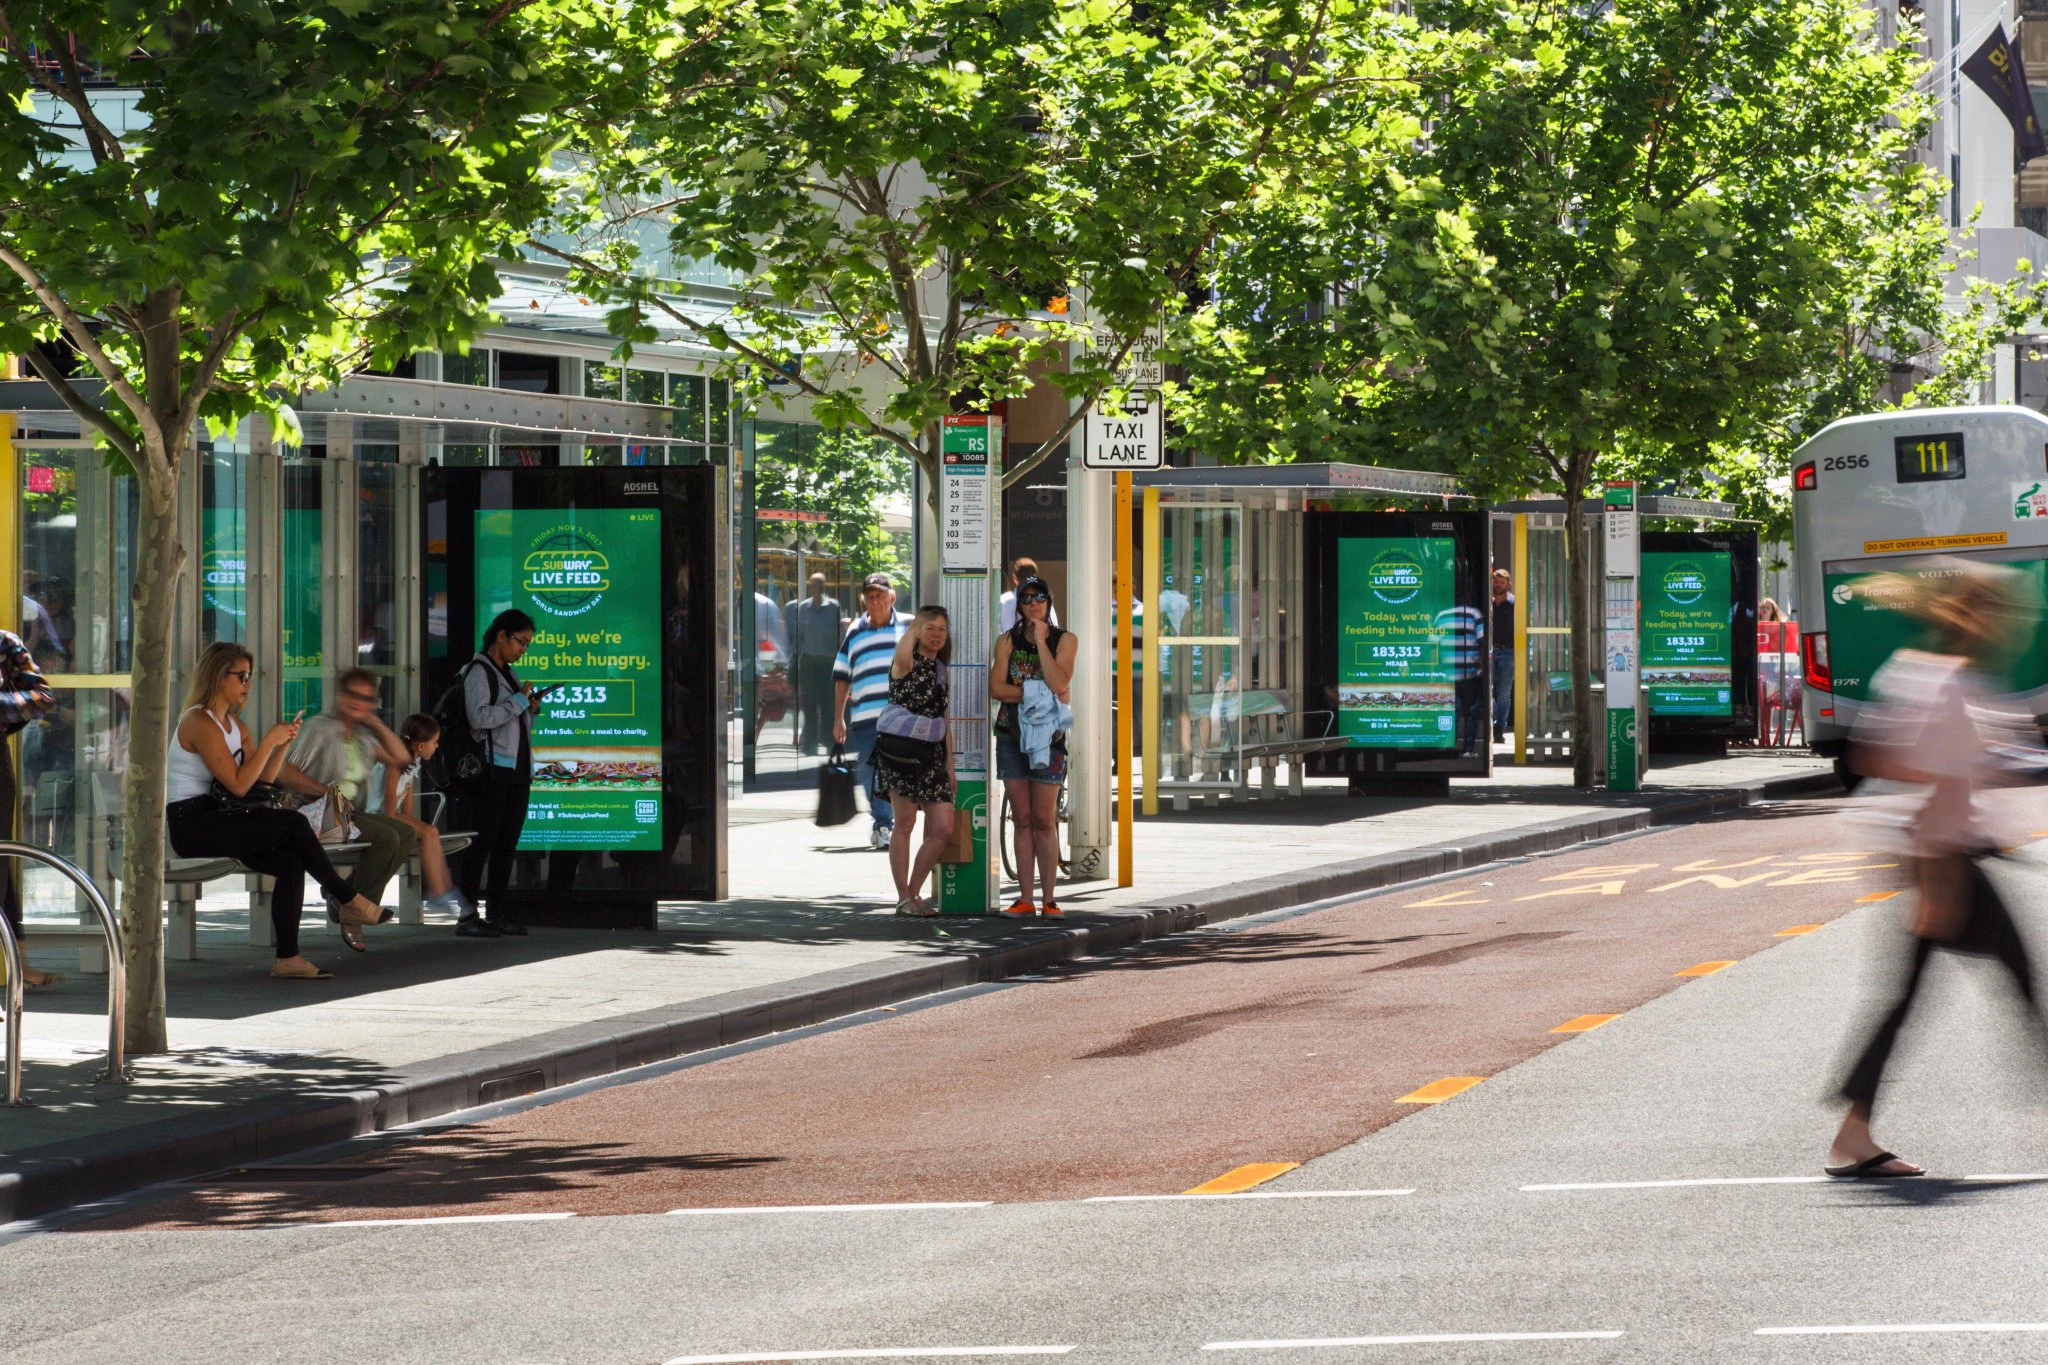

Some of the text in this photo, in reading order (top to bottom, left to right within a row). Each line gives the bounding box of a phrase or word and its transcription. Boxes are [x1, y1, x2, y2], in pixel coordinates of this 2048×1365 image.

[1136, 367, 1159, 379] LANE
[1103, 423, 1143, 439] TAXI
[968, 437, 985, 451] RS
[1098, 444, 1147, 460] LANE
[1915, 441, 1948, 473] 111
[1823, 454, 1870, 471] 2656
[624, 482, 660, 492] ADSHEL
[950, 479, 960, 487] 24
[950, 490, 960, 499] 25
[950, 504, 960, 513] 27
[637, 513, 655, 521] LIVE
[950, 519, 960, 527] 39
[531, 527, 556, 548] FRIDAY
[586, 530, 603, 547] 2017
[947, 530, 960, 538] 103
[945, 541, 960, 550] 935
[1867, 534, 2005, 551] DO NOT OVERTAKE TURNING VEHICLE
[543, 560, 593, 571] SUBWAY
[532, 572, 601, 585] LIVE FEED
[1918, 568, 1964, 579] VOLVO
[1374, 576, 1418, 585] LIVE FEED
[1863, 584, 1914, 597] Transperth
[531, 593, 603, 617] WORLD SANDWICH DAY
[1363, 611, 1431, 623] Today, we're
[1660, 610, 1713, 619] Today, we're
[1345, 625, 1449, 637] feeding the hungry.
[1645, 620, 1726, 630] feeding the hungry.
[576, 629, 622, 644] we're
[1666, 637, 1705, 648] 183,313
[1372, 646, 1422, 659] 183,313
[513, 652, 651, 670] ding the hungry.
[1832, 678, 1860, 686] B7R
[551, 709, 586, 719] MEALS
[623, 728, 649, 737] charity.
[1610, 740, 1618, 770] Georges
[1610, 771, 1617, 780] St
[558, 812, 609, 820] #SubwayLiveFeed
[1539, 851, 1879, 882] BUS
[946, 882, 956, 895] St
[1401, 863, 1901, 909] LANE
